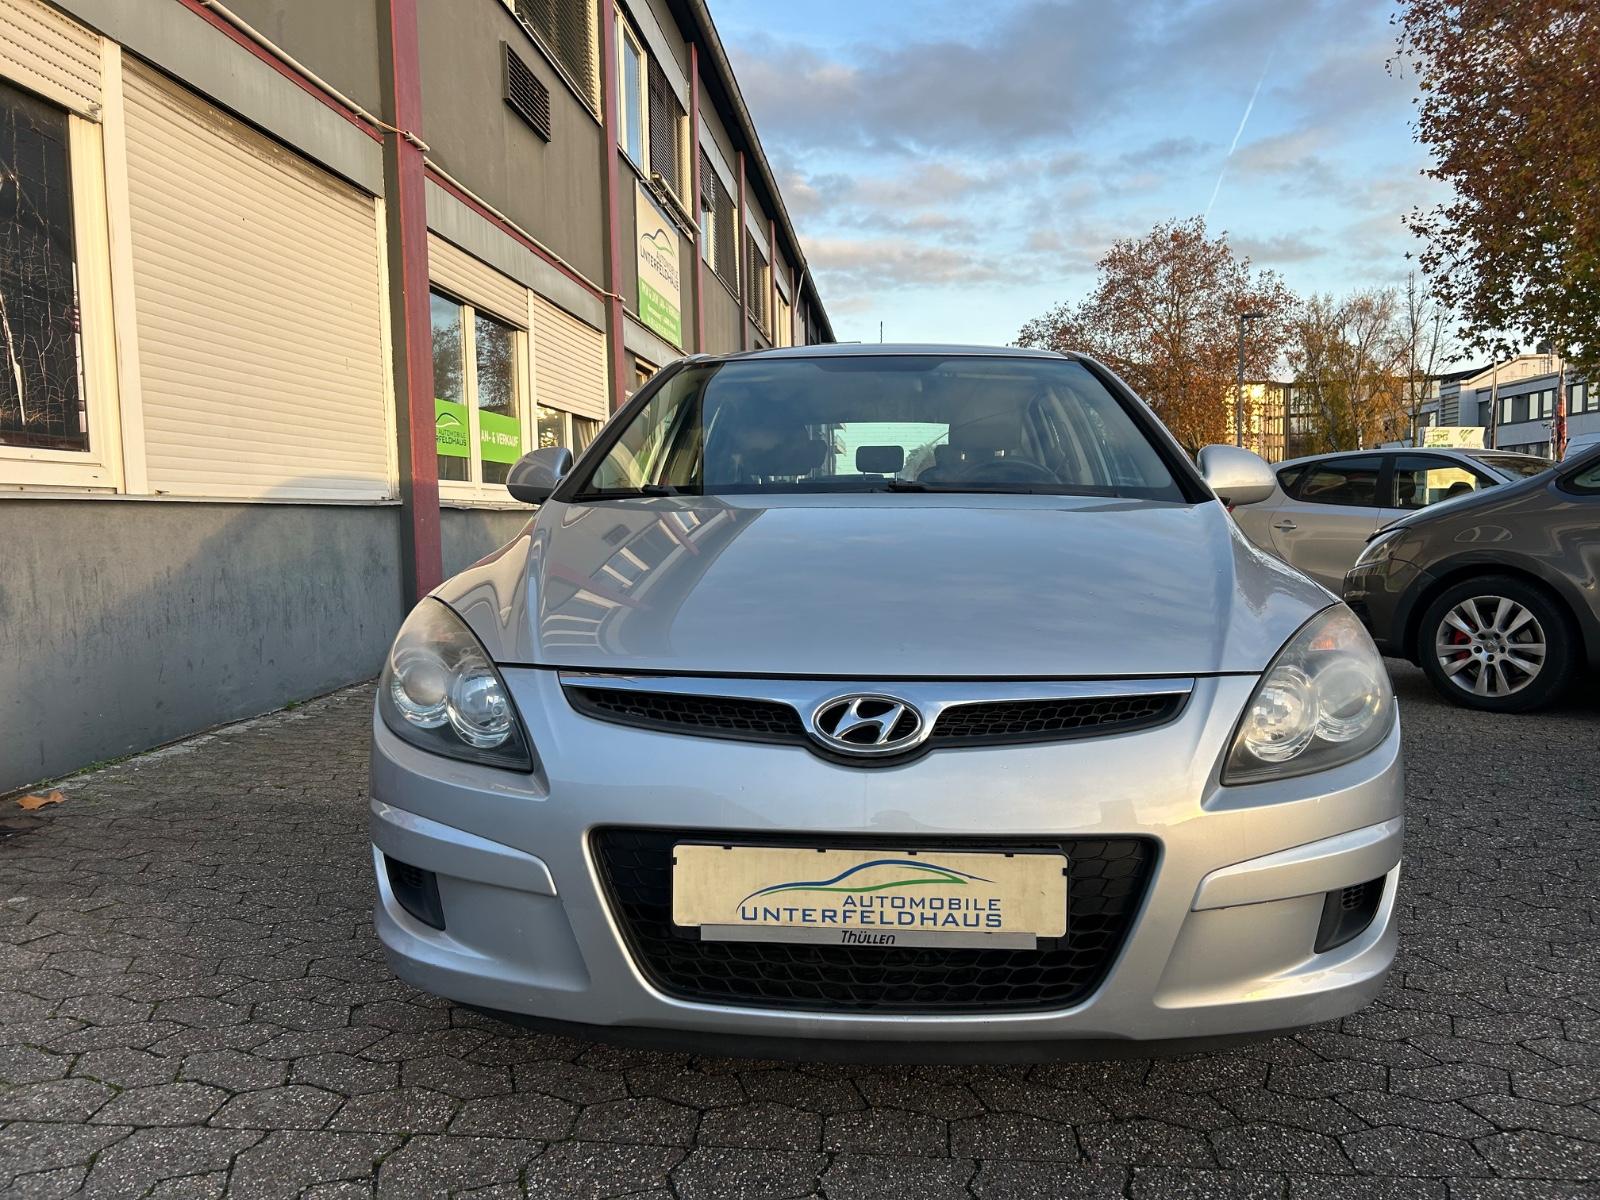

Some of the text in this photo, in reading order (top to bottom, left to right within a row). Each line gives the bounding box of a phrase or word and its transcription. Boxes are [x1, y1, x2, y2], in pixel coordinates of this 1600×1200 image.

[640, 246, 679, 292] UNTERFELDHAUS
[438, 428, 467, 439] AUTOMOBILE
[496, 432, 519, 447] VERKAUF
[842, 895, 1001, 911] AUTOMOBILE
[741, 905, 1002, 928] UNTERFELDHAUS
